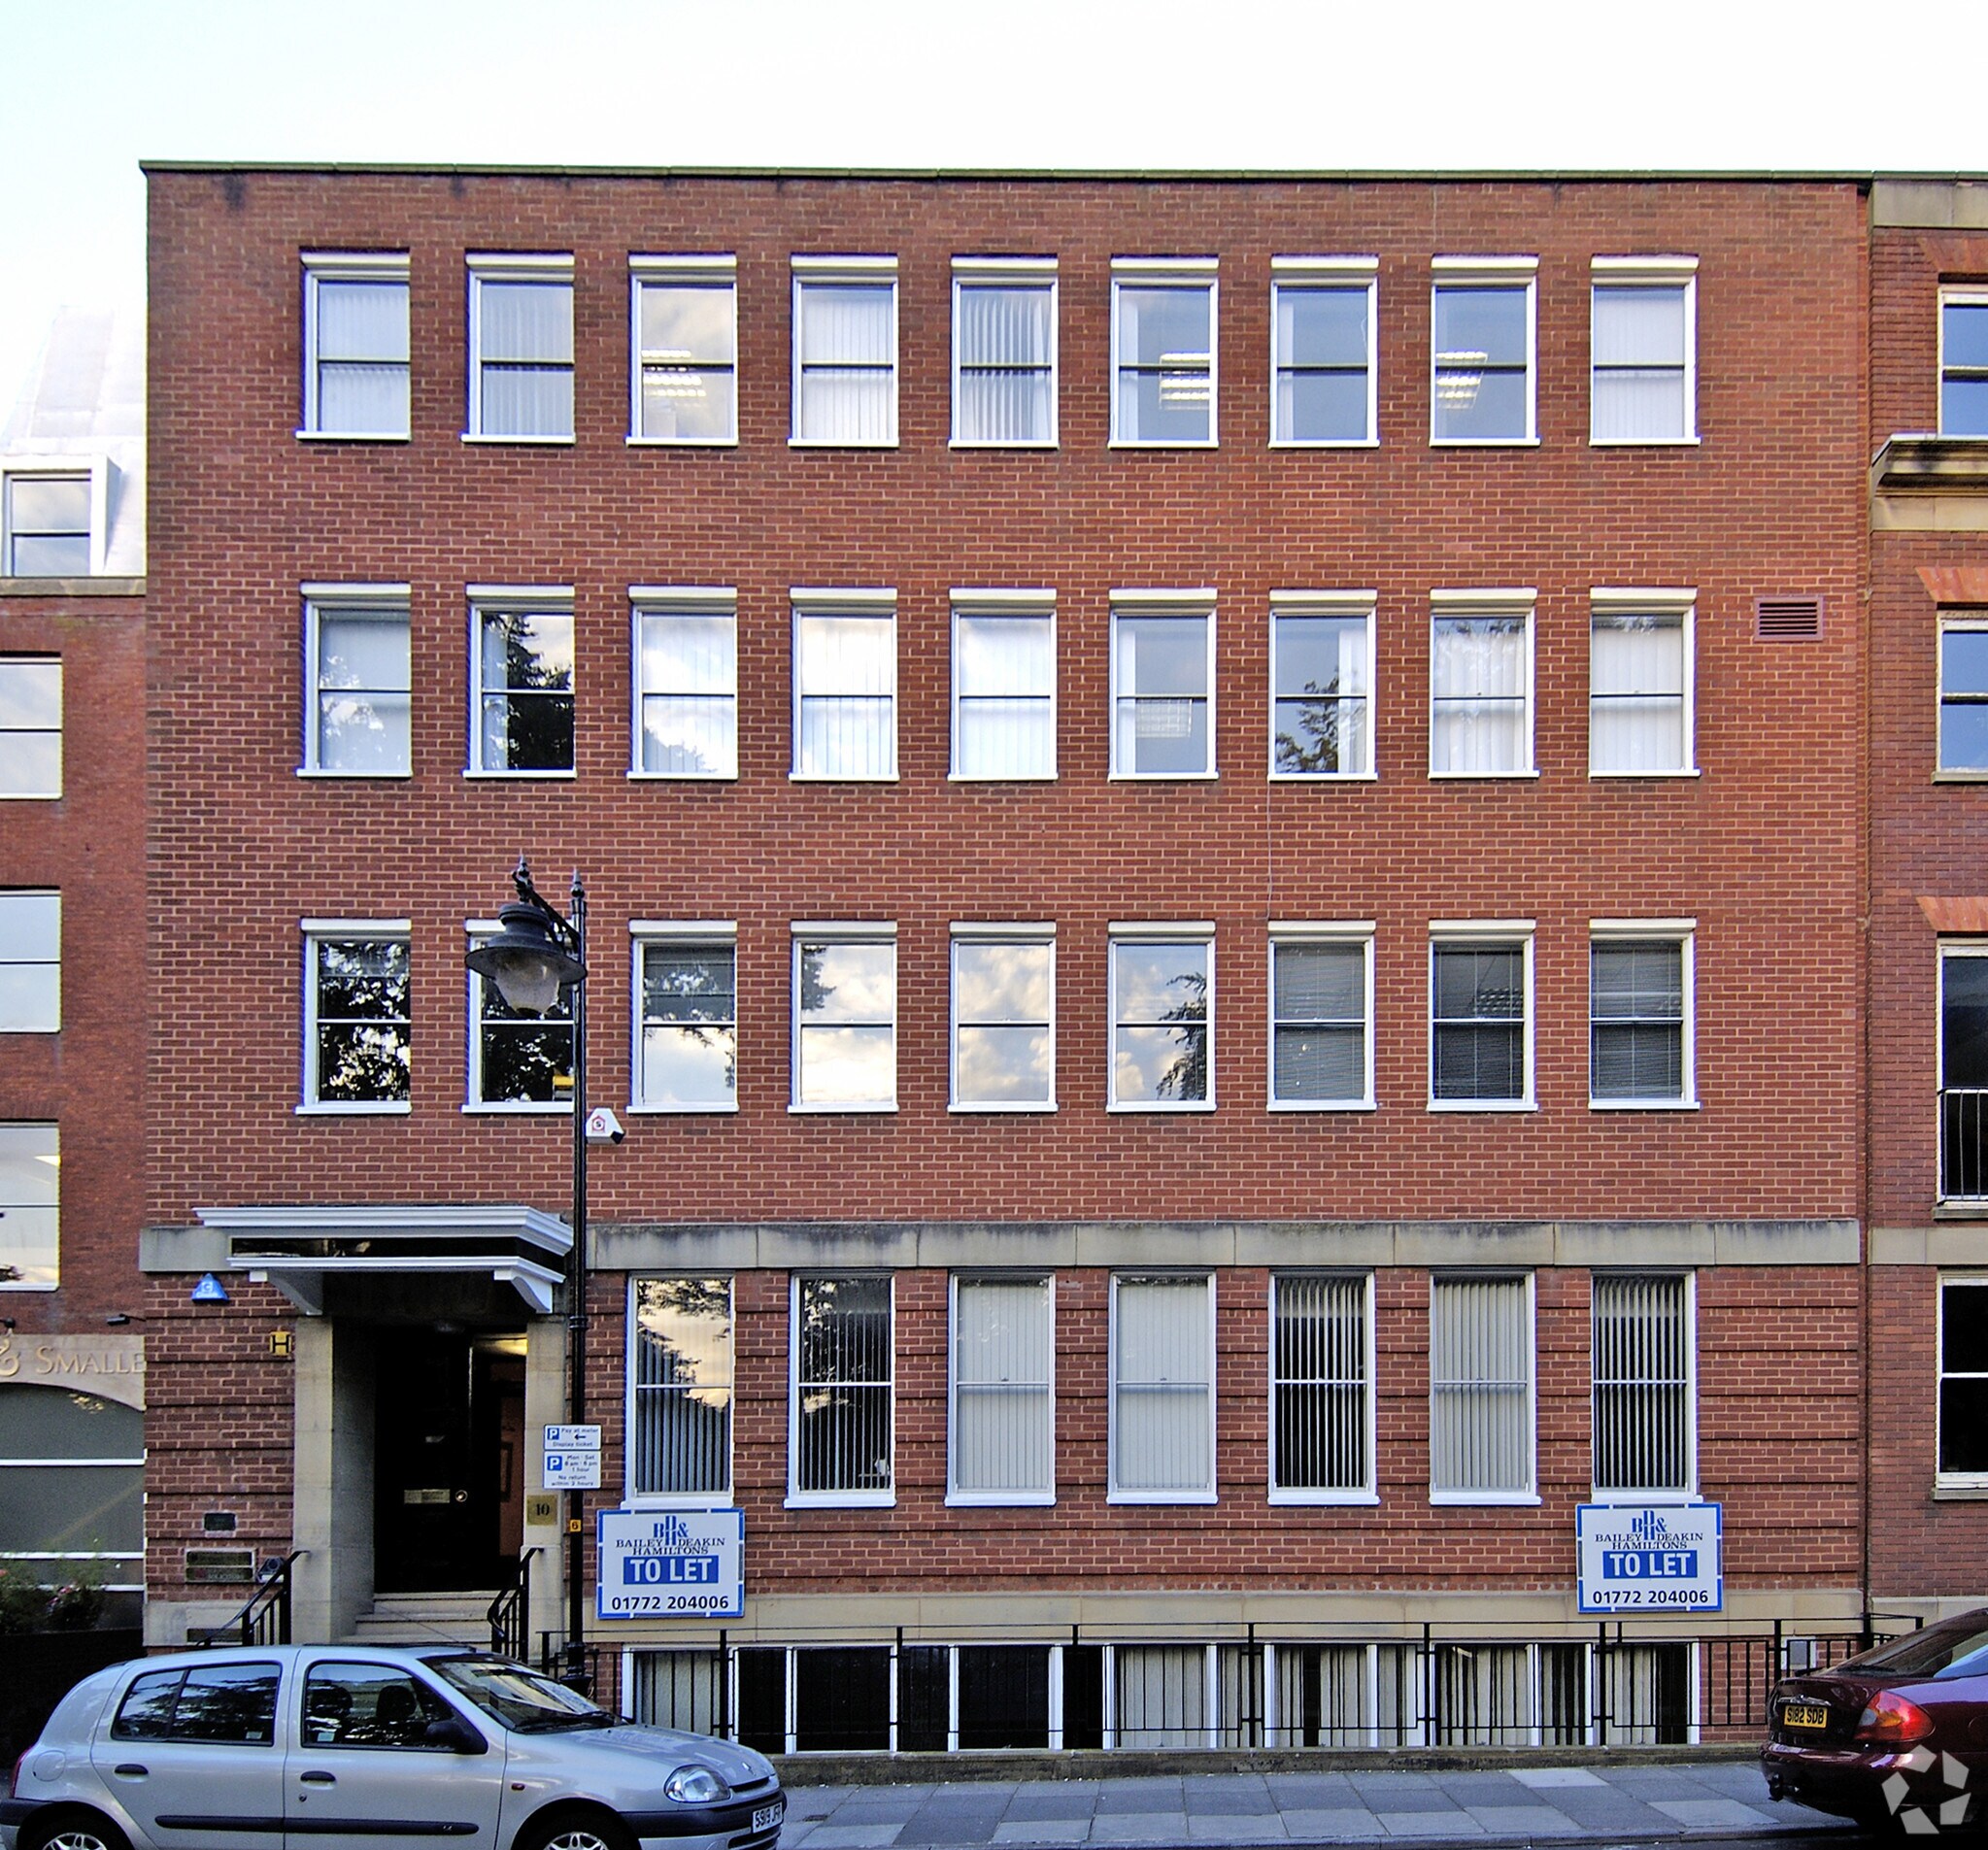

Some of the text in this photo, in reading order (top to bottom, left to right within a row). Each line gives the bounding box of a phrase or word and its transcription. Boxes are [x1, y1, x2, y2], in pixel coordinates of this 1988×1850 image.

[272, 1334, 290, 1354] H
[549, 1428, 558, 1440] P
[550, 1457, 560, 1470] P
[536, 1502, 551, 1516] 10
[616, 1537, 725, 1548] BAILEY DEAKIN
[1595, 1532, 1703, 1542] BAILEY DEAKIN
[632, 1546, 709, 1556] HAMILTONS
[1612, 1541, 1688, 1550] HAMILTONS
[629, 1558, 712, 1583] TO LET
[1609, 1553, 1691, 1577] TO LET
[612, 1596, 728, 1611] 01772 204006
[1593, 1590, 1708, 1604] 01772 204006
